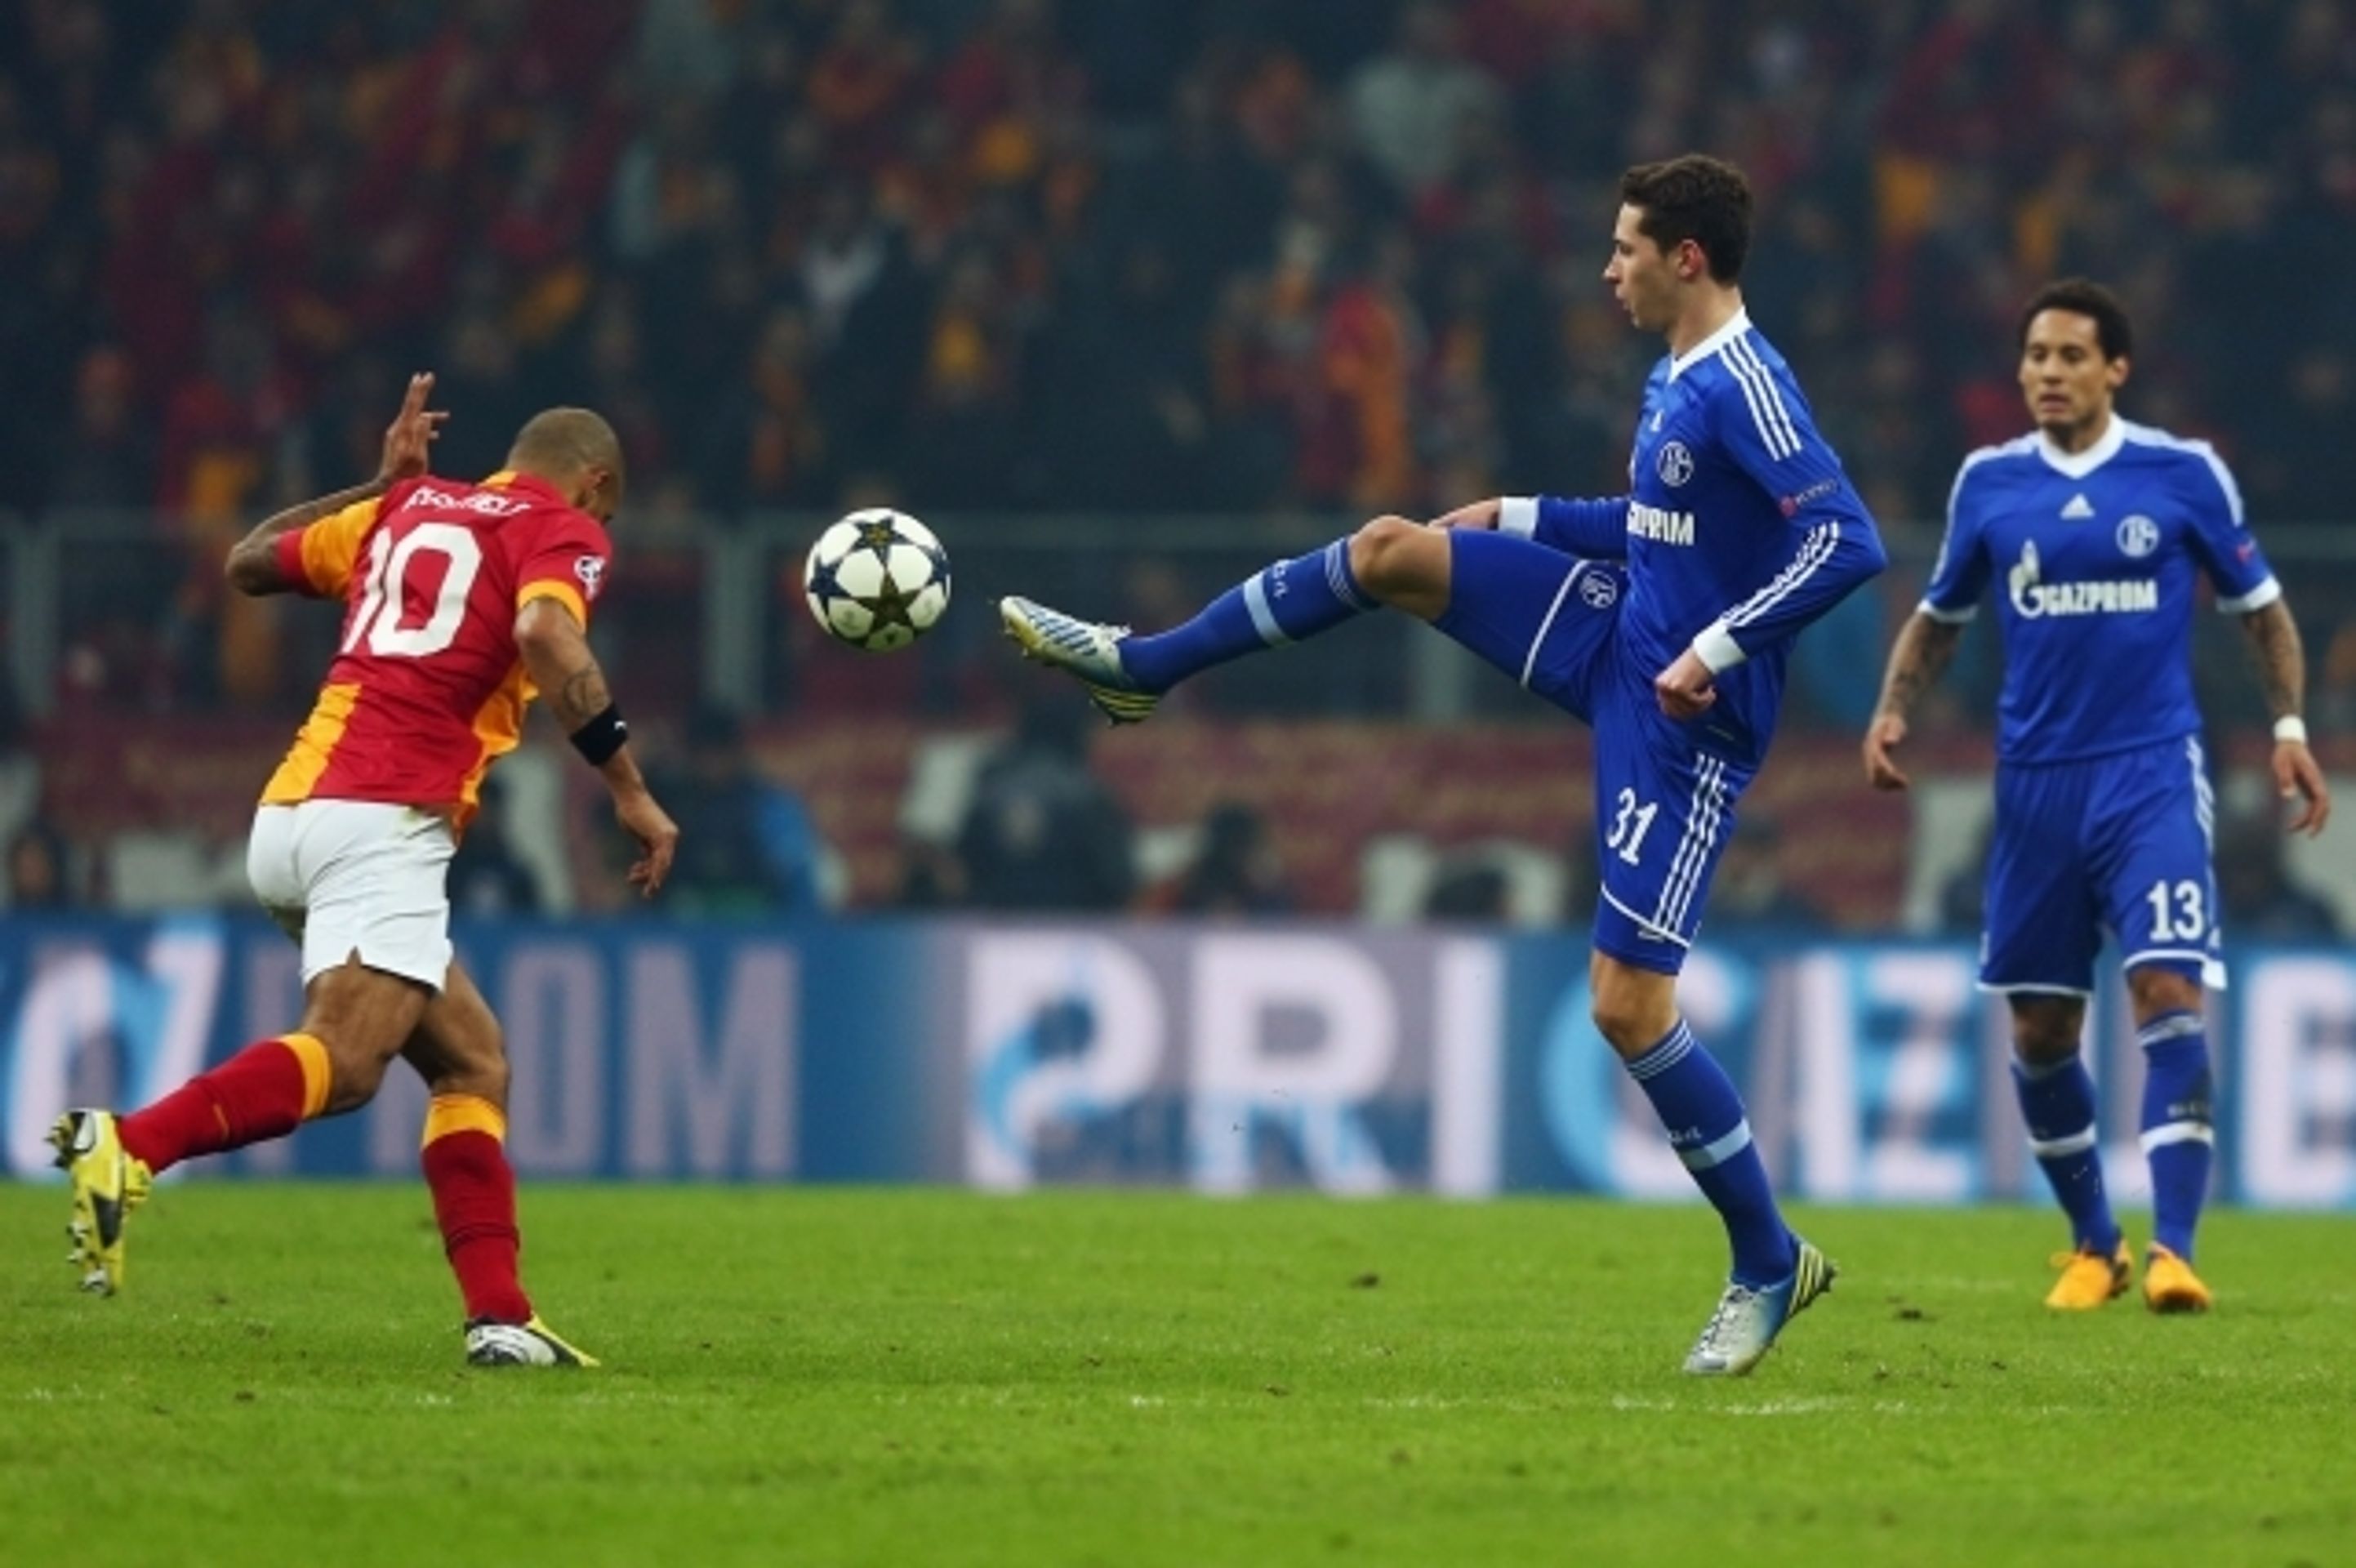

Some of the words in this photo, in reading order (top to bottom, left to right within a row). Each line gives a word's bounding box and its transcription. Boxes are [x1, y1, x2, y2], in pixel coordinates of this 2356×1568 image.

[341, 522, 483, 657] 10
[2042, 577, 2158, 617] GAZPROM
[1606, 786, 1659, 866] 31
[2146, 879, 2204, 942] 13
